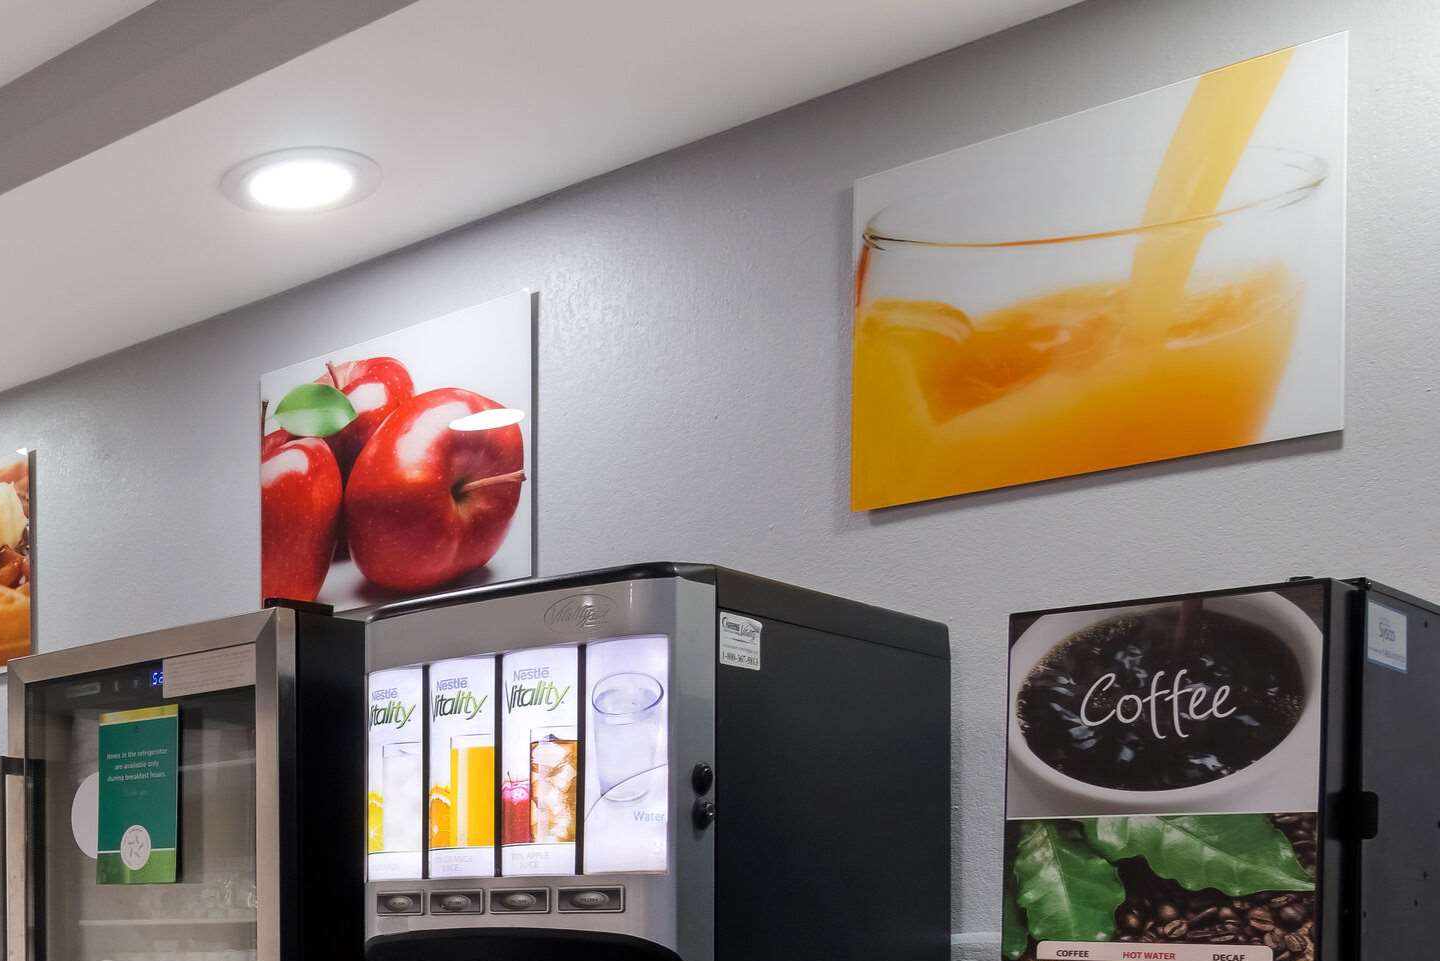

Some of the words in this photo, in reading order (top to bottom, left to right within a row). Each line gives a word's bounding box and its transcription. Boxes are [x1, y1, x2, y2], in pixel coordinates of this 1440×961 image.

[1080, 669, 1237, 739] Coffee
[633, 809, 665, 822] Water
[1056, 949, 1089, 958] COFFEE
[1122, 951, 1142, 960] HOT
[1144, 951, 1176, 960] WATER
[1212, 953, 1246, 961] DECAF
